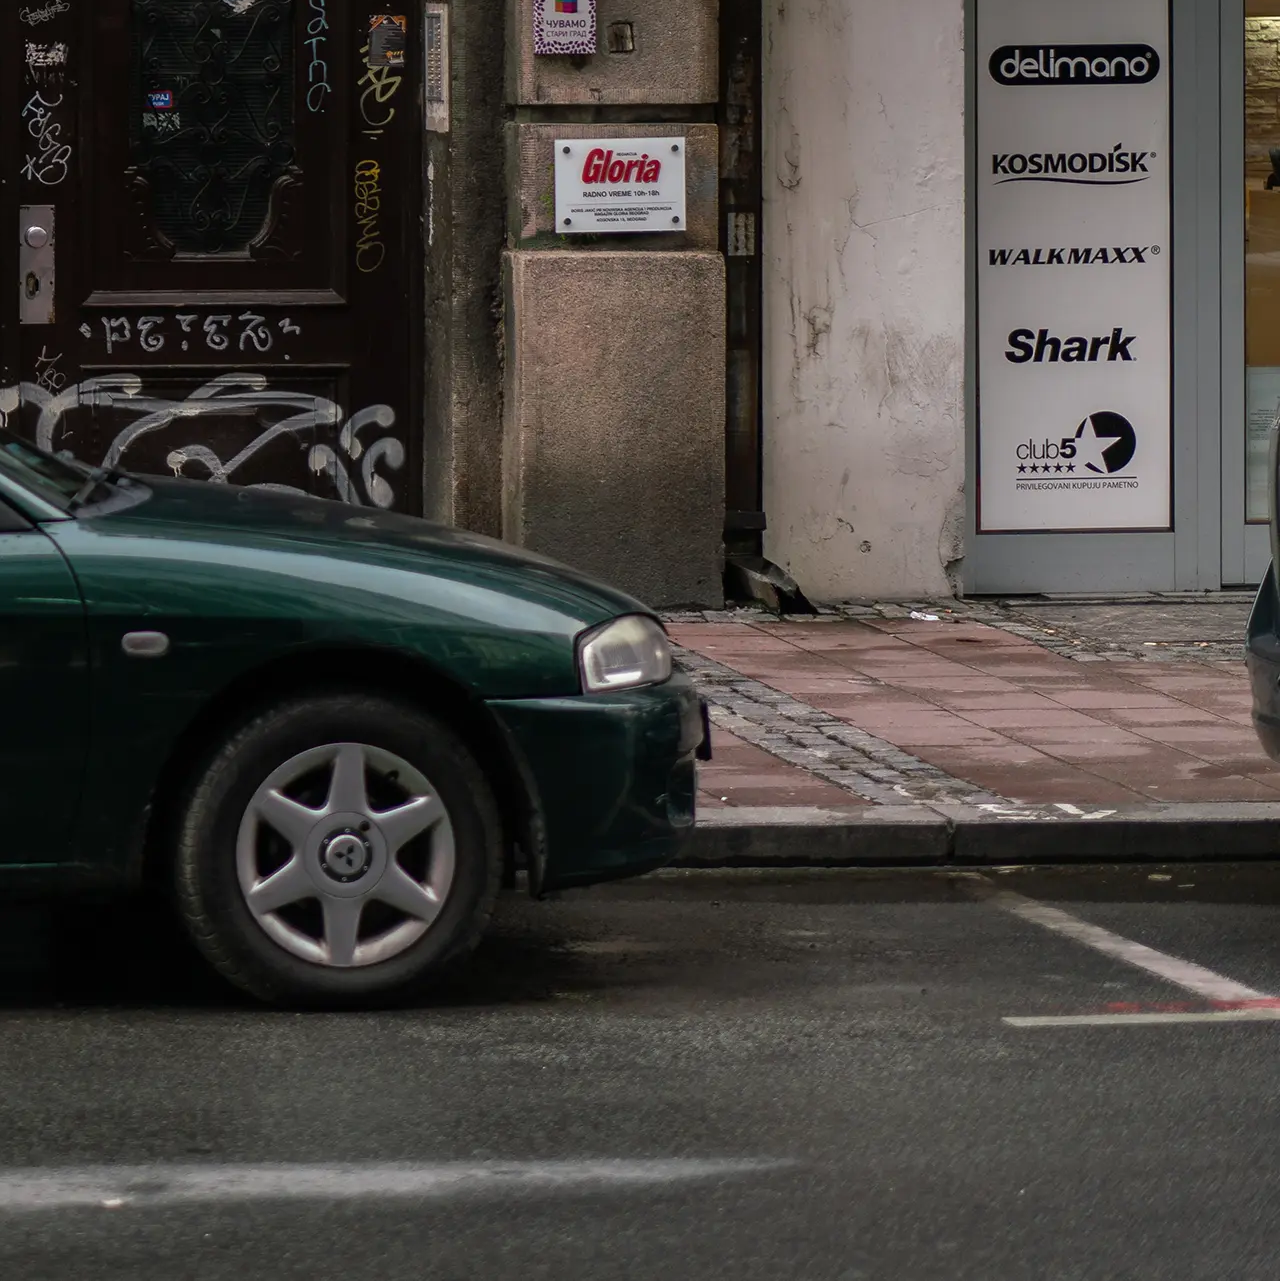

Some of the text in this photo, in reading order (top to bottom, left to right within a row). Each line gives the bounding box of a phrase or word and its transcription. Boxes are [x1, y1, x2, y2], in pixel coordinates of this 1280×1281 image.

[546, 19, 587, 29] ЧУВАМО
[546, 30, 587, 38] СТАРИ ГРАД
[999, 50, 1149, 79] delimano
[582, 148, 661, 184] Gloria
[988, 247, 1148, 266] WALKMAXX
[1004, 328, 1134, 364] Shark
[1016, 481, 1139, 491] PRIVILEGOVANI KUPUJU PAMETNO
